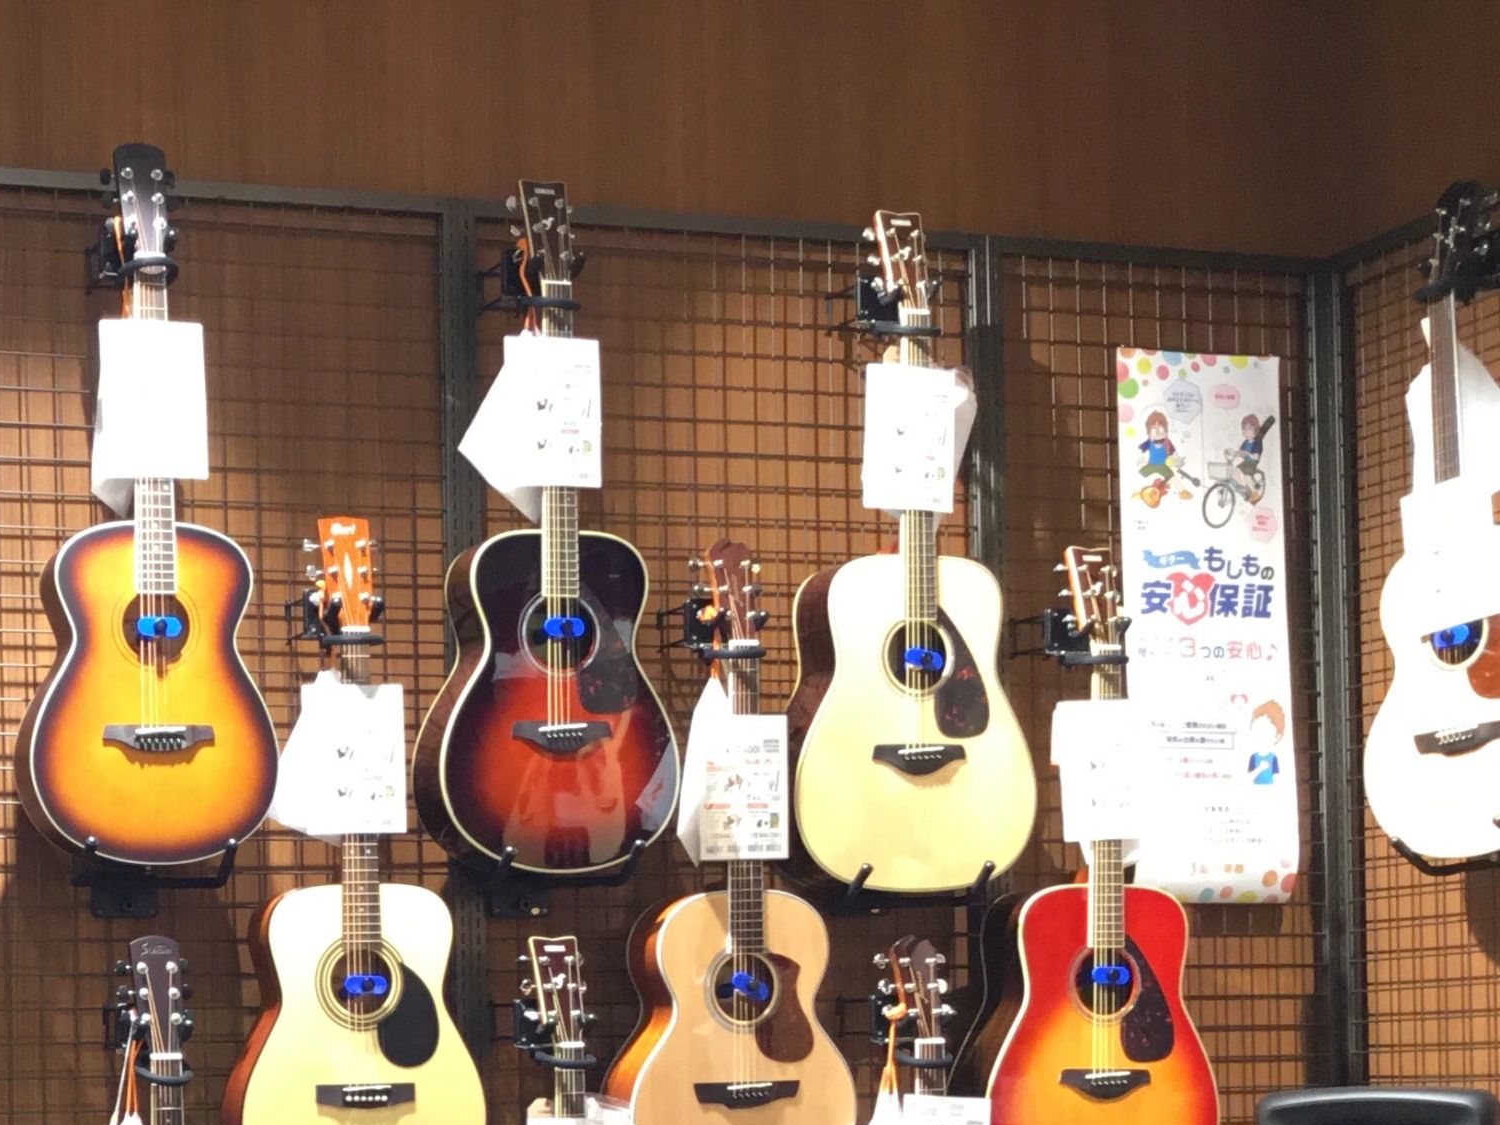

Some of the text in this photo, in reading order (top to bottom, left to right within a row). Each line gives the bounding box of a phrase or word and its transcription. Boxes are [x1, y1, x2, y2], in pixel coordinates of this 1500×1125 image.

[1204, 546, 1275, 580] もしもの
[1141, 579, 1274, 619] 安心保証
